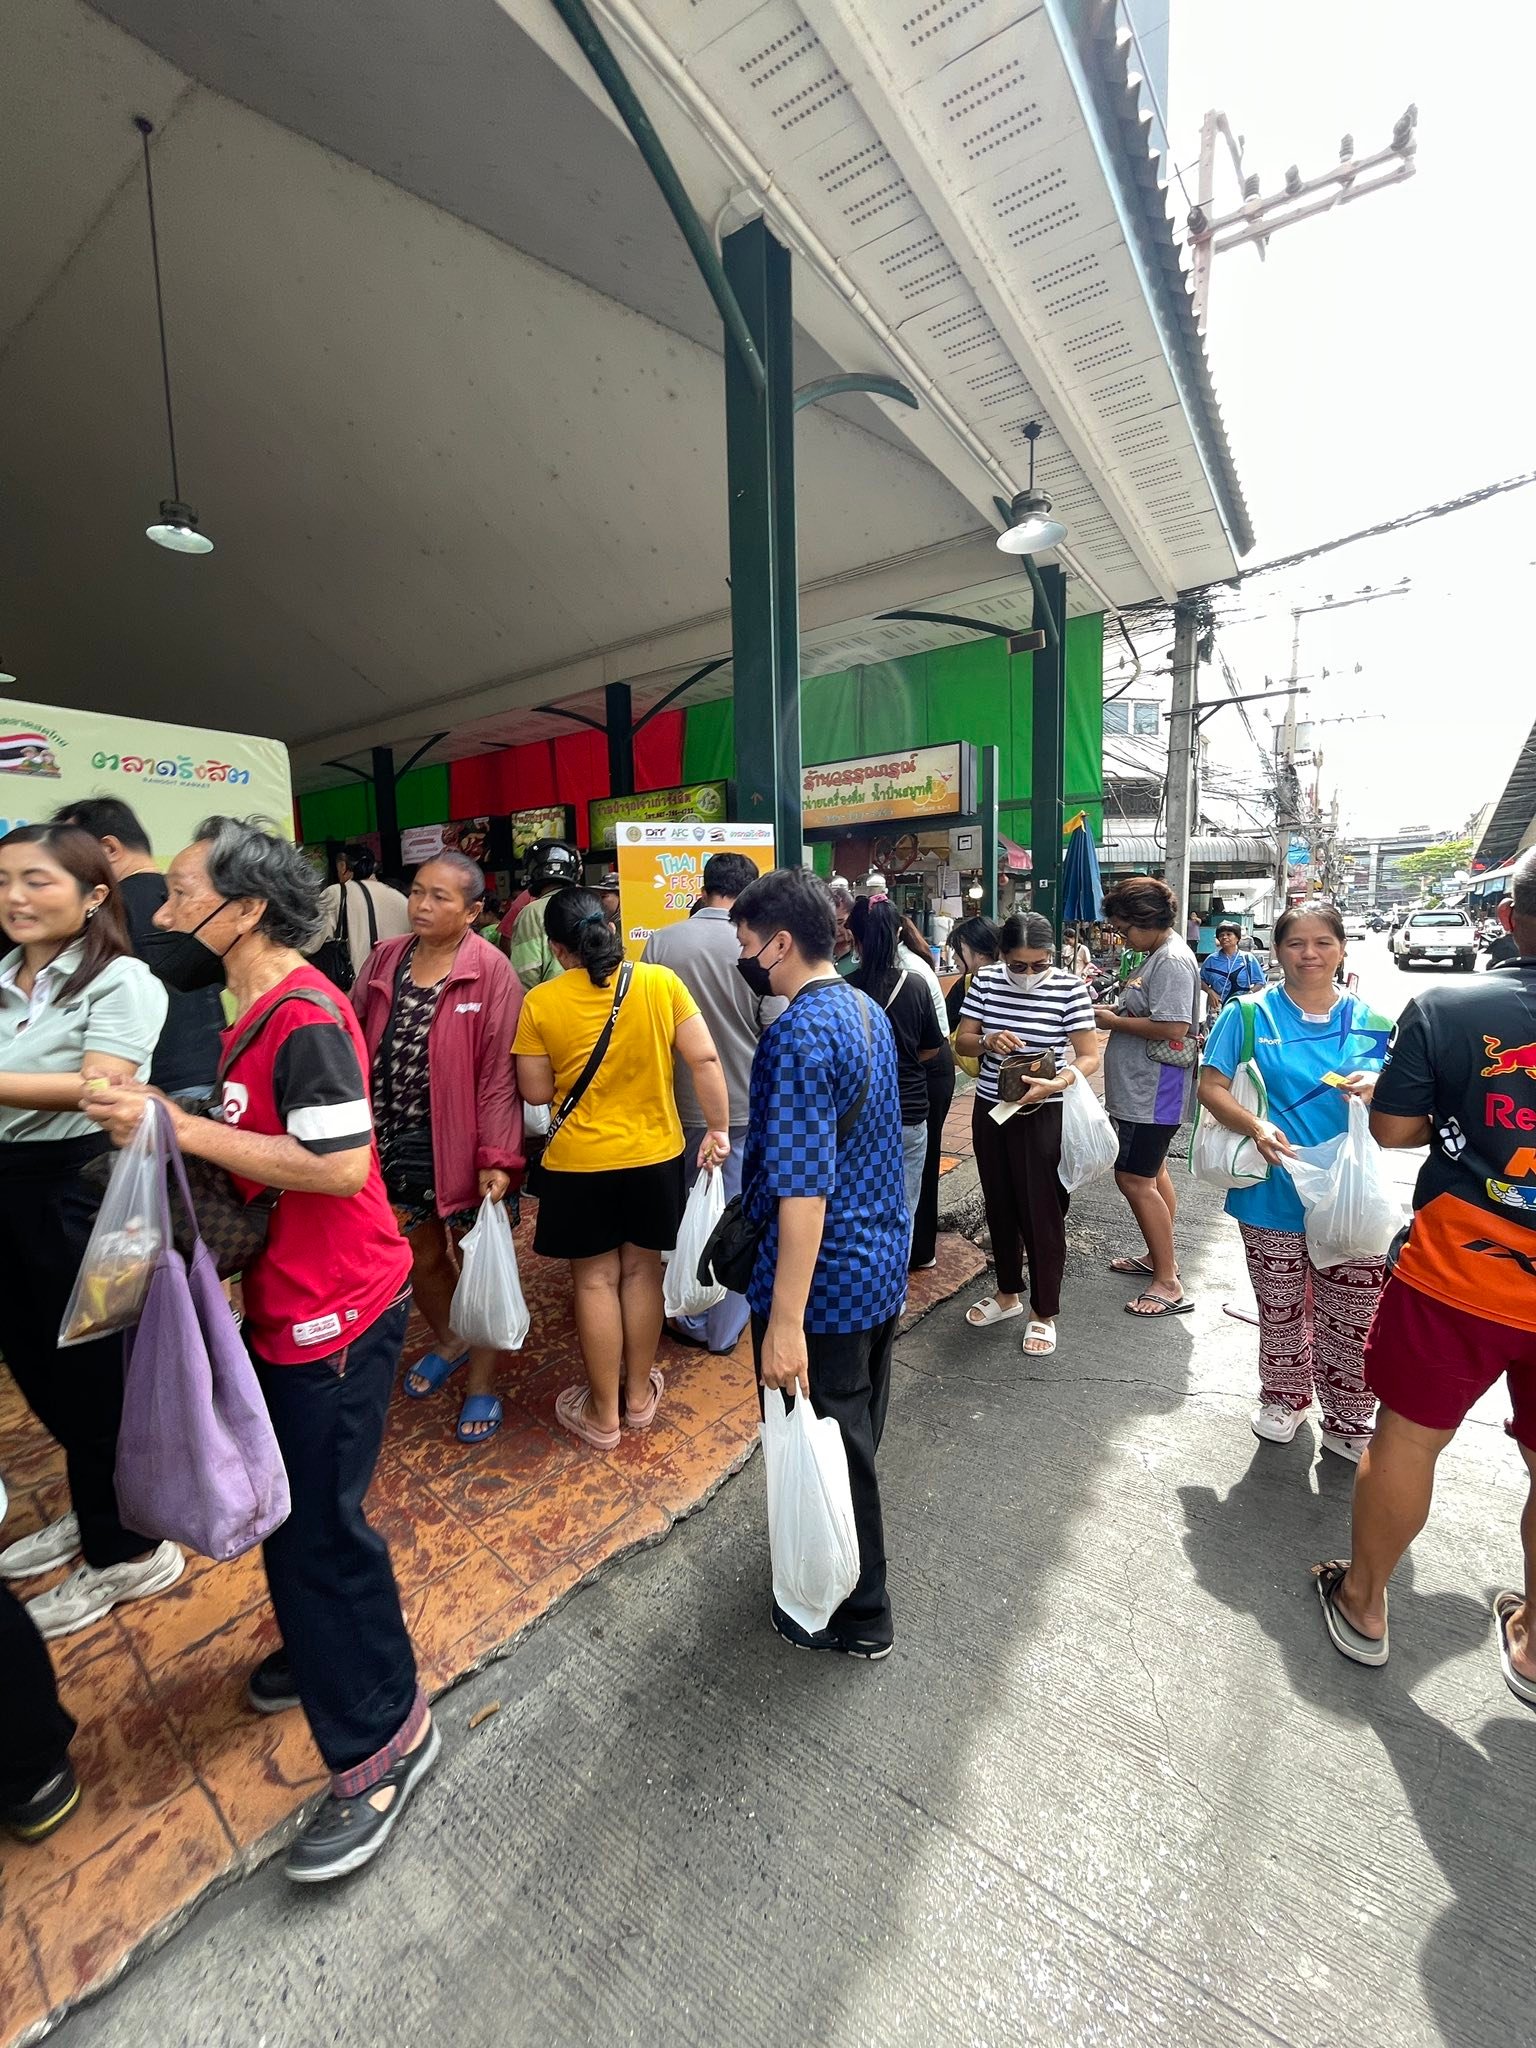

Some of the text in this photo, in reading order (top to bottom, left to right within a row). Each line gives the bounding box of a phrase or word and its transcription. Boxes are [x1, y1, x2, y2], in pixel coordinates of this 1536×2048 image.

[91, 751, 250, 785] ตลาดรังสิต
[656, 853, 696, 875] THAI
